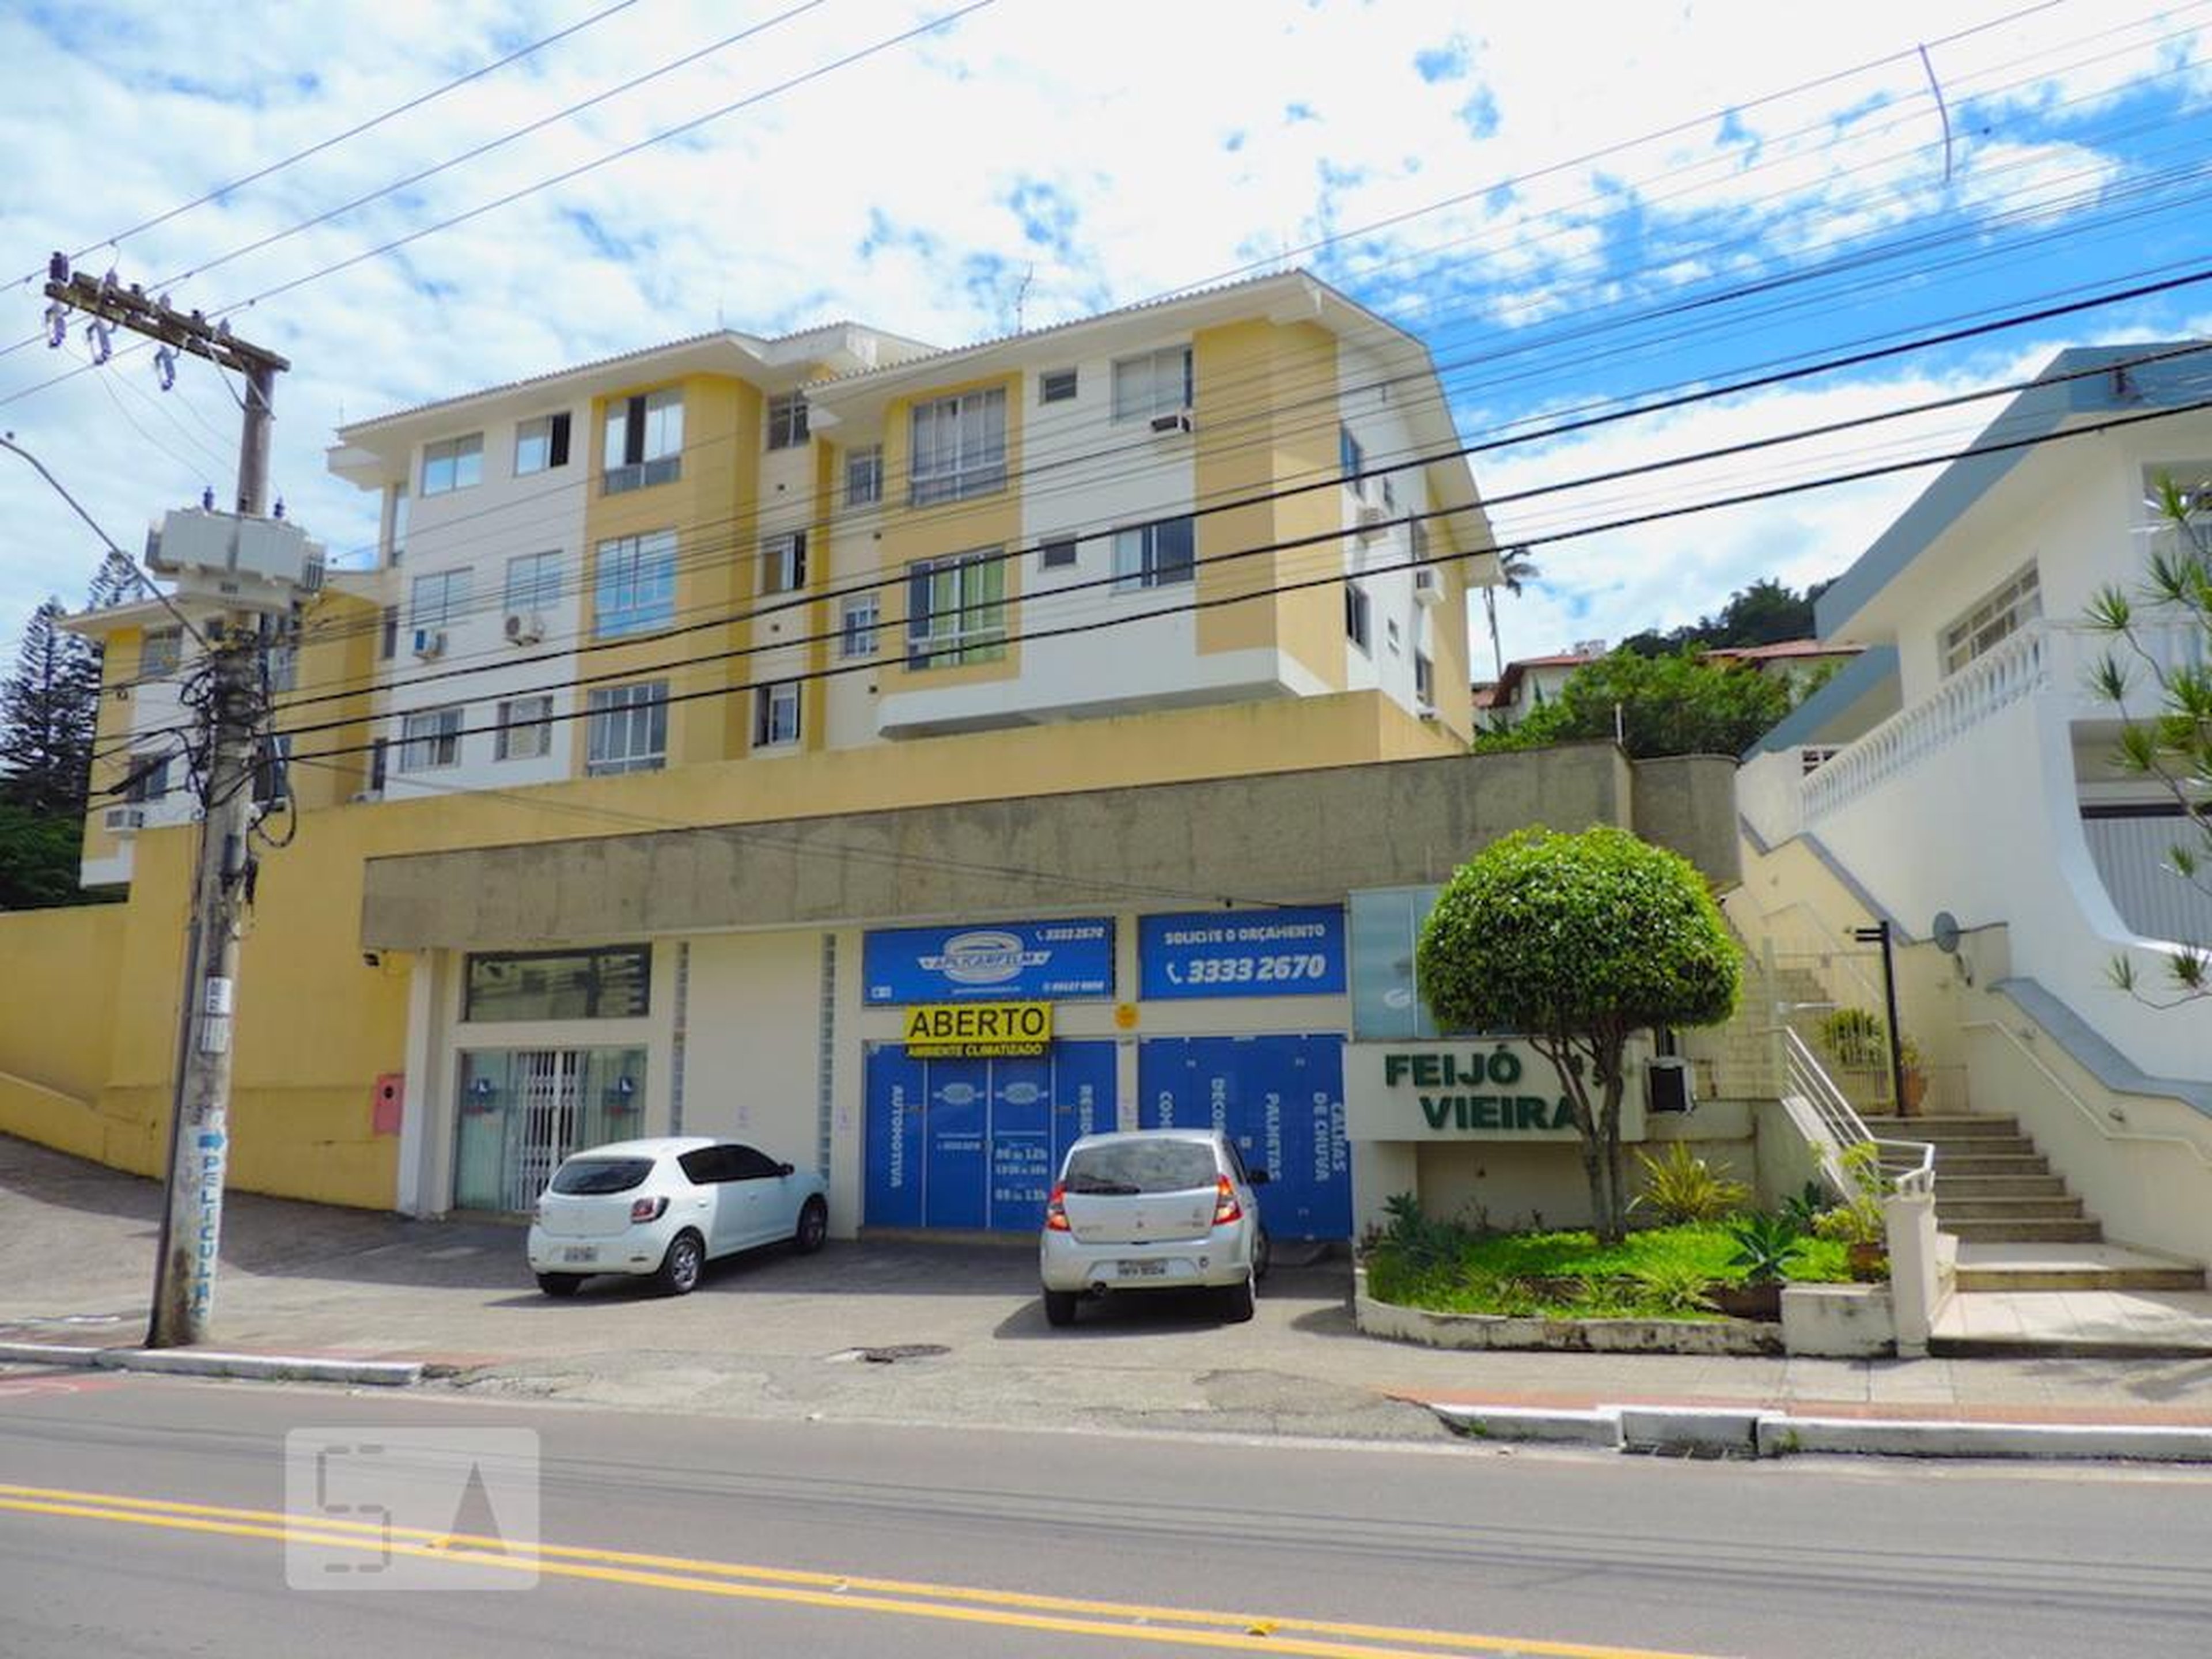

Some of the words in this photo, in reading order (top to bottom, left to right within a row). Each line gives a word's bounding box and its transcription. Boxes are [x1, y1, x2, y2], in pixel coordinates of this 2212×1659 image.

[1164, 930, 1222, 945] SOLICITE
[1225, 929, 1236, 941] O
[1239, 924, 1325, 942] ORÇAMENTO
[1187, 957, 1253, 983] 3333
[1257, 954, 1325, 980] 2670
[910, 1007, 1044, 1037] ABERTO
[964, 1043, 1043, 1056] CLIMATIZADO
[1385, 1043, 1521, 1086] FEIJÓ
[1313, 1092, 1327, 1119] DE
[891, 1084, 904, 1188] AUTOMOTIVA
[1266, 1092, 1282, 1181] PALHETAS
[1315, 1120, 1330, 1181] CHUVA
[1331, 1102, 1347, 1172] CALHAS
